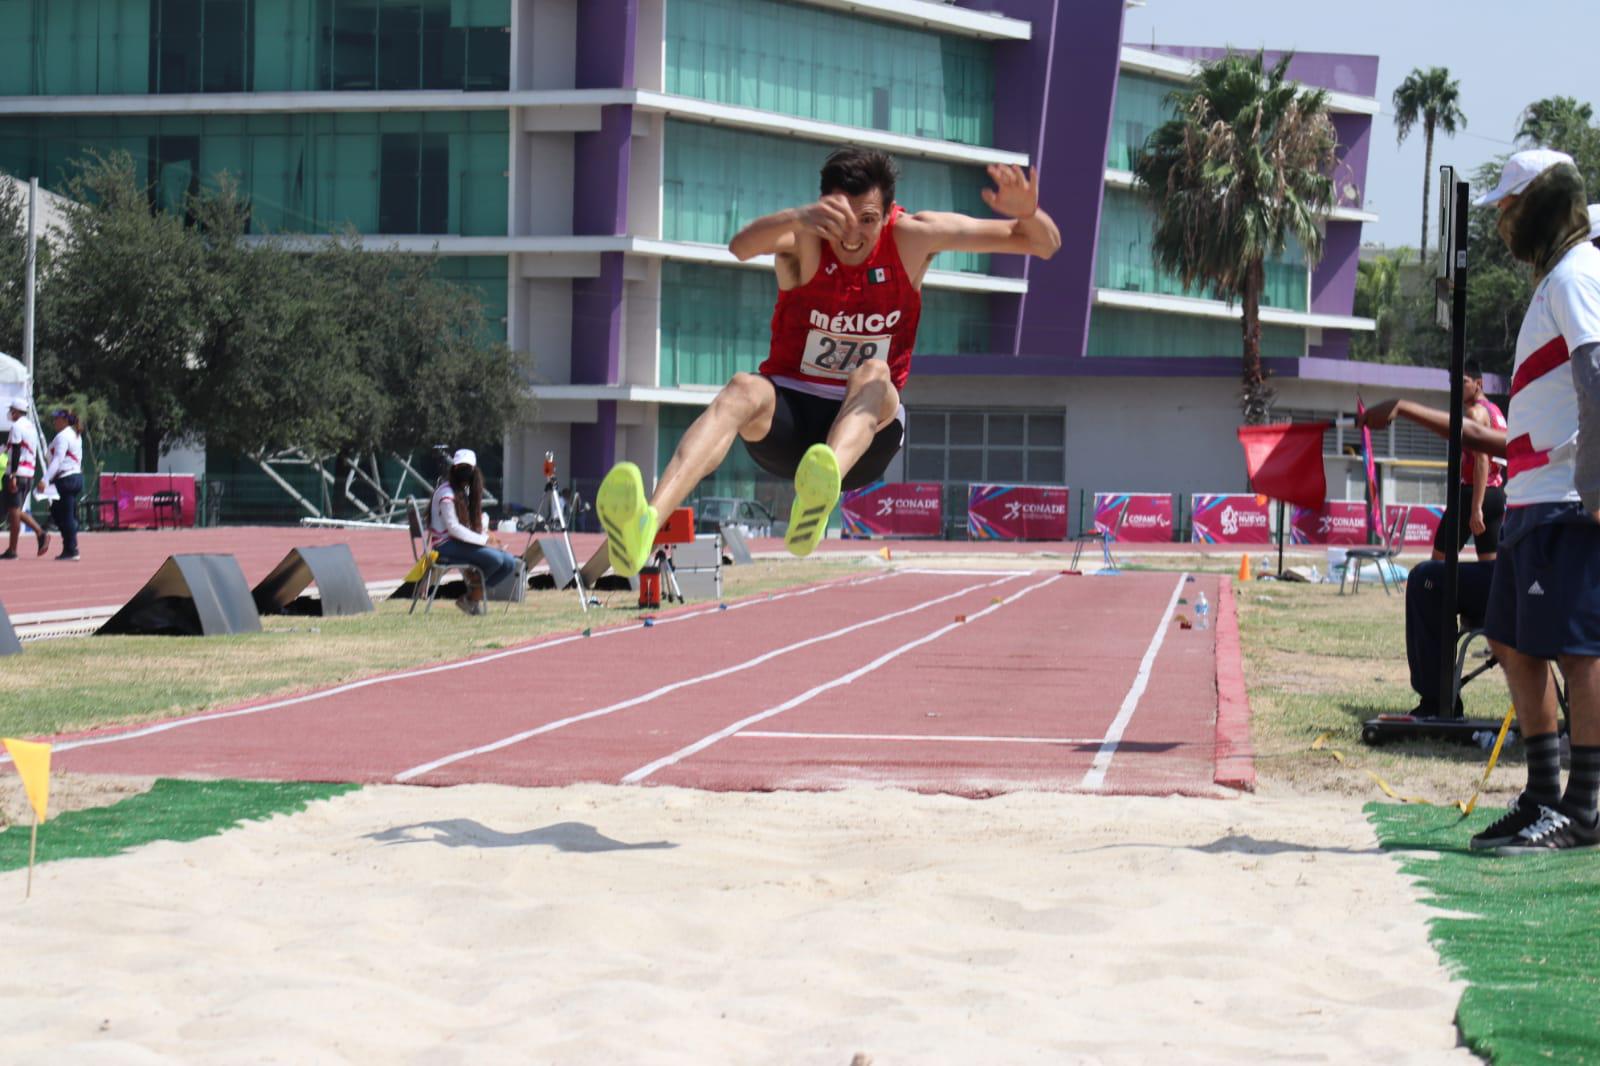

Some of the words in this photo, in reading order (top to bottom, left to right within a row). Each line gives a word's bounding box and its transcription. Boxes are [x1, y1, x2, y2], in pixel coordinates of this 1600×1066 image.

[809, 309, 901, 333] MÉXICO
[895, 498, 939, 509] CONADE
[1022, 503, 1066, 514] CONADE
[1238, 514, 1267, 523] NUEVO
[1332, 517, 1365, 527] CONADE
